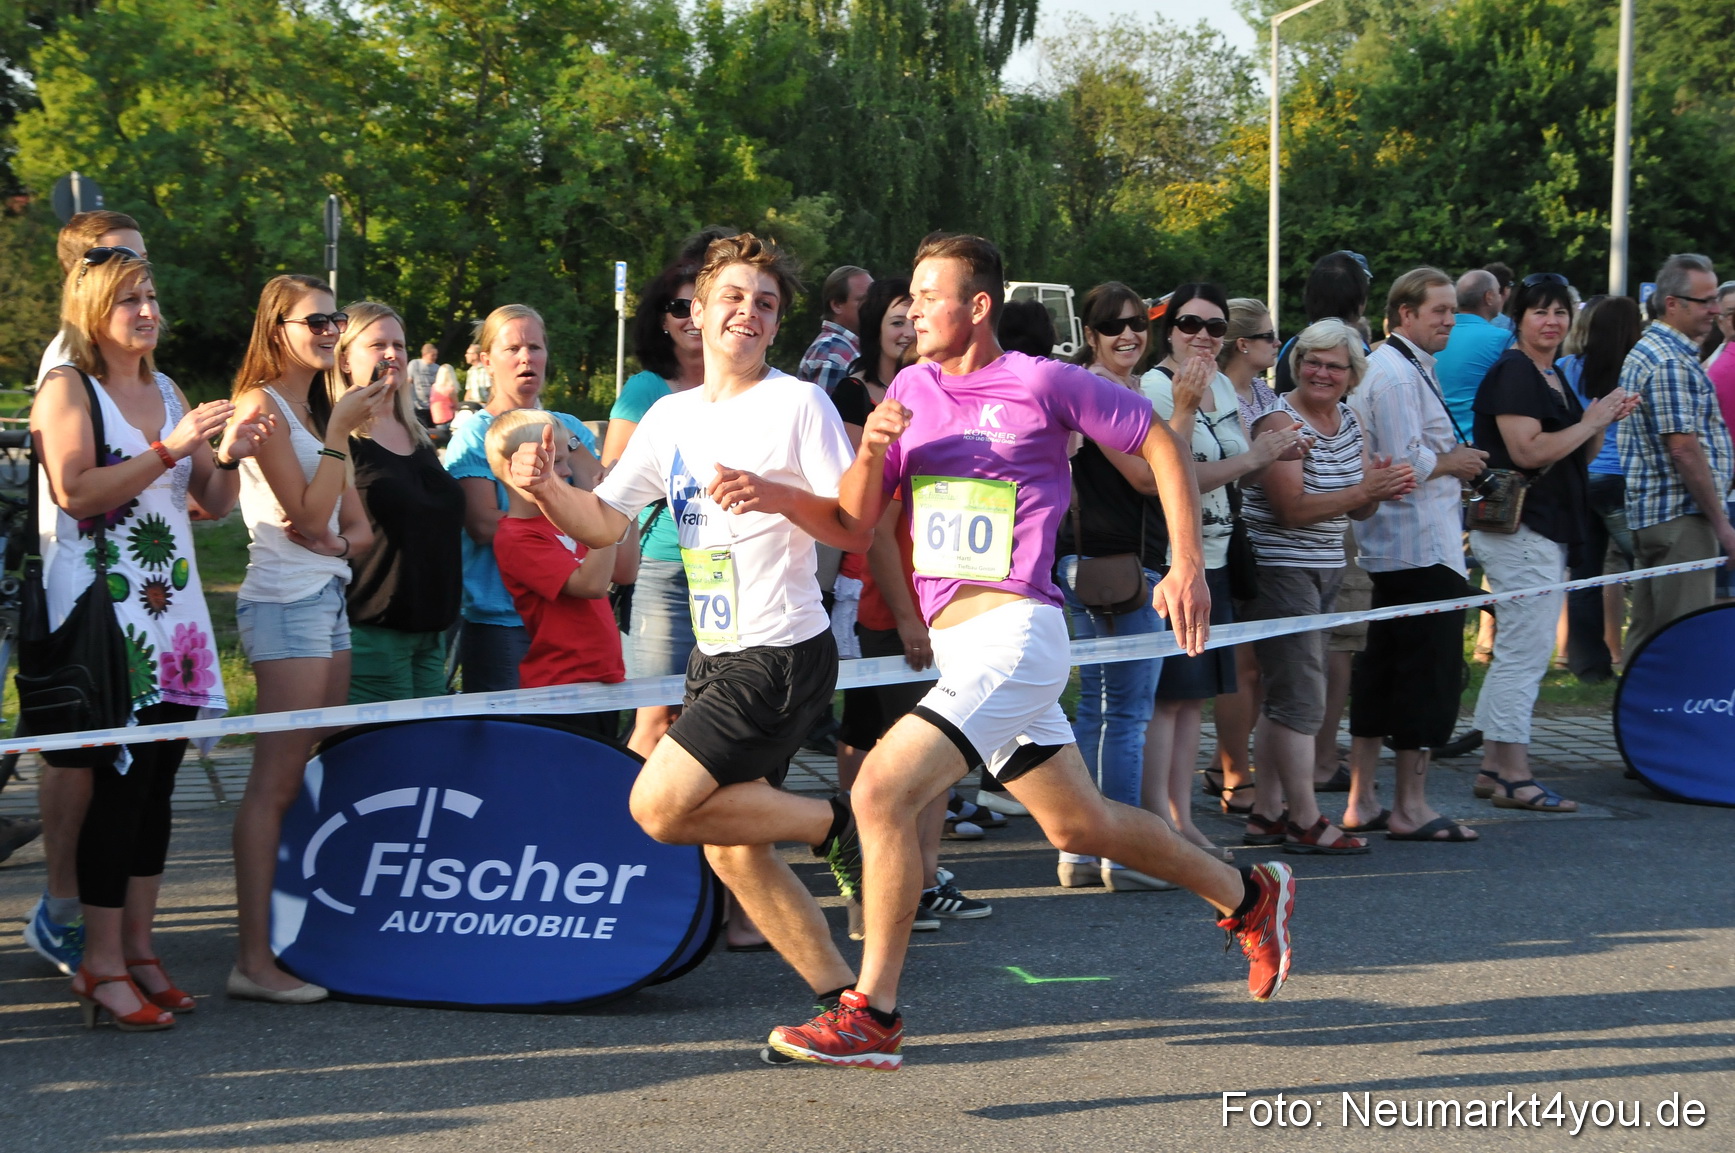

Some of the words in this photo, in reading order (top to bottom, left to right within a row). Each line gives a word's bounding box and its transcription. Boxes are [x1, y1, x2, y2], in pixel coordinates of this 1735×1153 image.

[979, 403, 1004, 428] K
[927, 511, 994, 554] 610
[1683, 688, 1735, 716] und
[360, 842, 647, 904] Fischer
[379, 910, 617, 939] AUTOMOBILE
